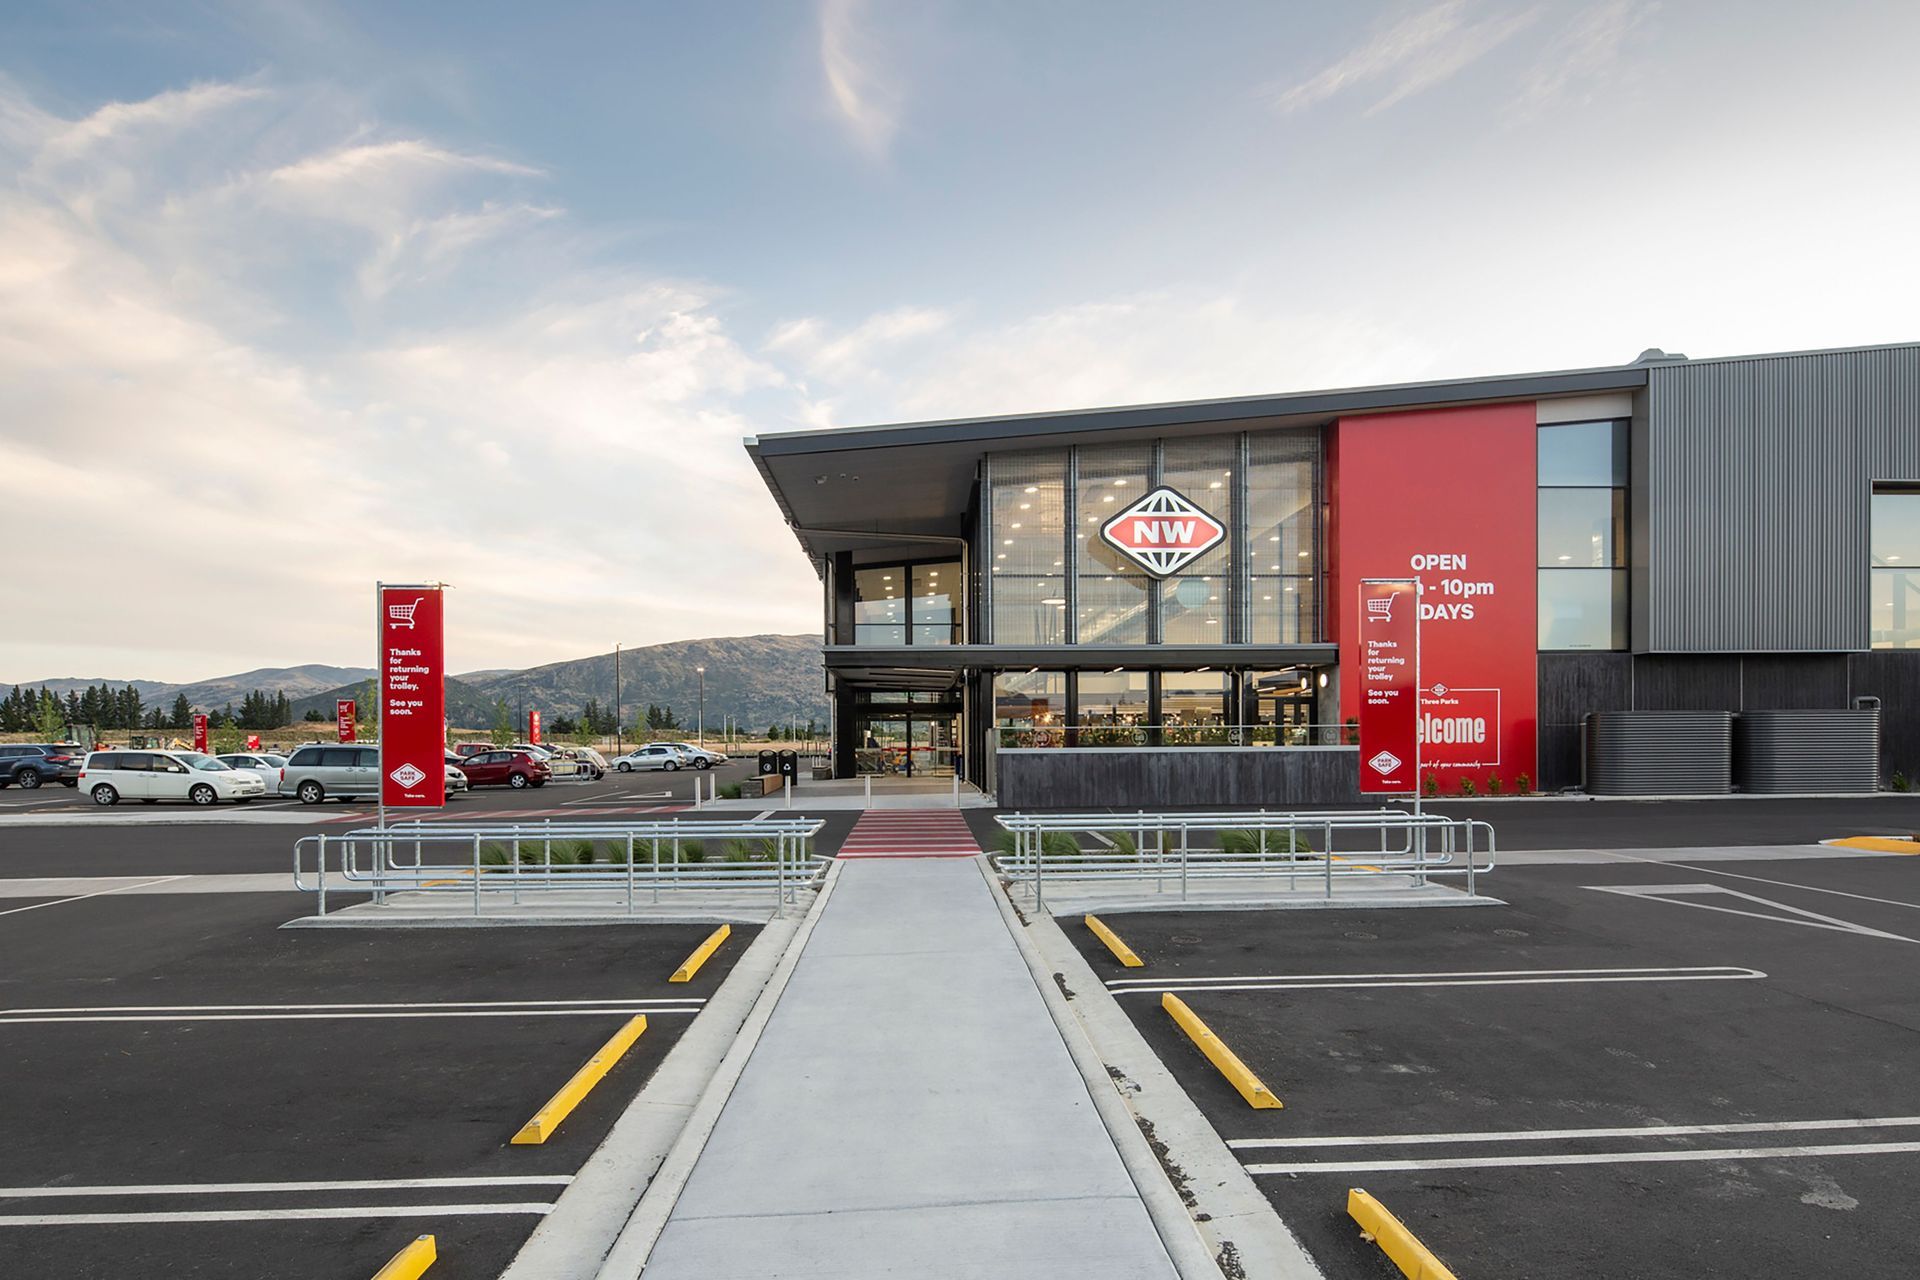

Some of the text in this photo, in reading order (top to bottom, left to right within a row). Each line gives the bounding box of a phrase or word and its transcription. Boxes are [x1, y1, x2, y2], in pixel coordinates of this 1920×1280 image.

[1133, 520, 1196, 544] NW
[1410, 554, 1467, 571] OPEN
[1441, 579, 1495, 598] 10pm
[1420, 603, 1474, 620] DAYS
[1368, 640, 1397, 648] Thanks
[390, 648, 421, 656] Thanks
[1368, 648, 1379, 656] for
[390, 657, 402, 665] for
[1368, 656, 1405, 666] returning
[390, 665, 429, 674] returning
[1368, 666, 1386, 674] your
[390, 674, 409, 682] your
[390, 682, 419, 691] trolley.
[1368, 689, 1399, 698] See you
[390, 699, 423, 708] See you
[390, 708, 413, 716] soon.
[1419, 712, 1486, 744] lcome
